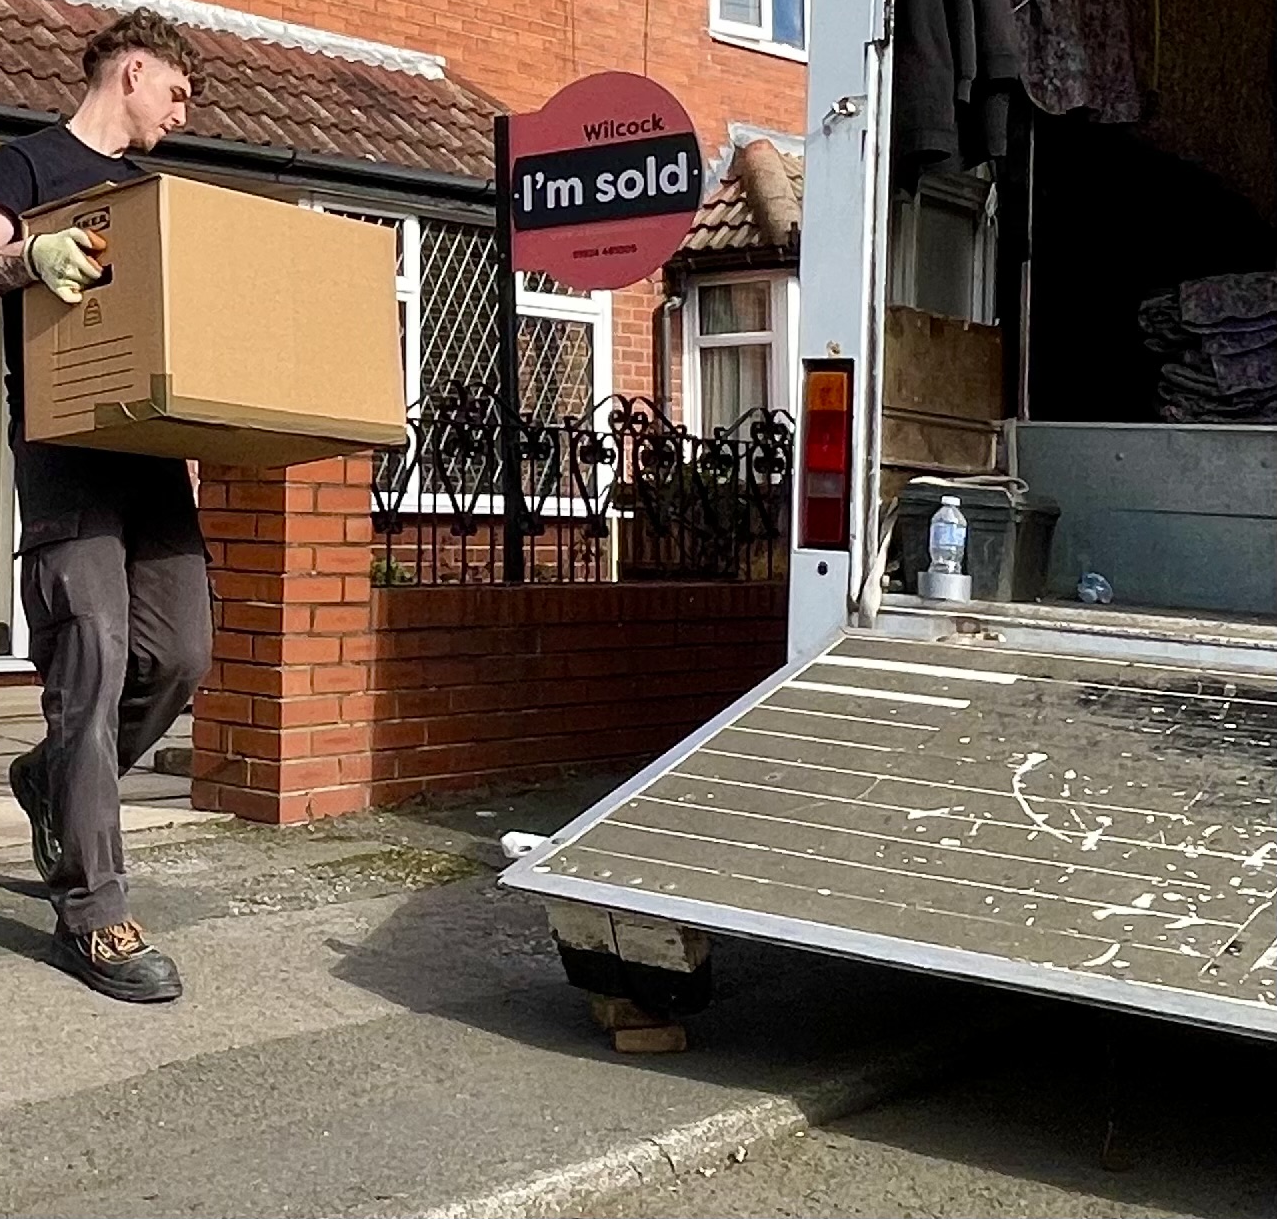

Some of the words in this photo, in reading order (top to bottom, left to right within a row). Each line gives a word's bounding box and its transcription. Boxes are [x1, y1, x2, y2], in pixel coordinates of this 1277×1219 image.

[583, 113, 665, 142] Wilcock
[523, 171, 584, 212] I'm
[596, 152, 688, 203] sold
